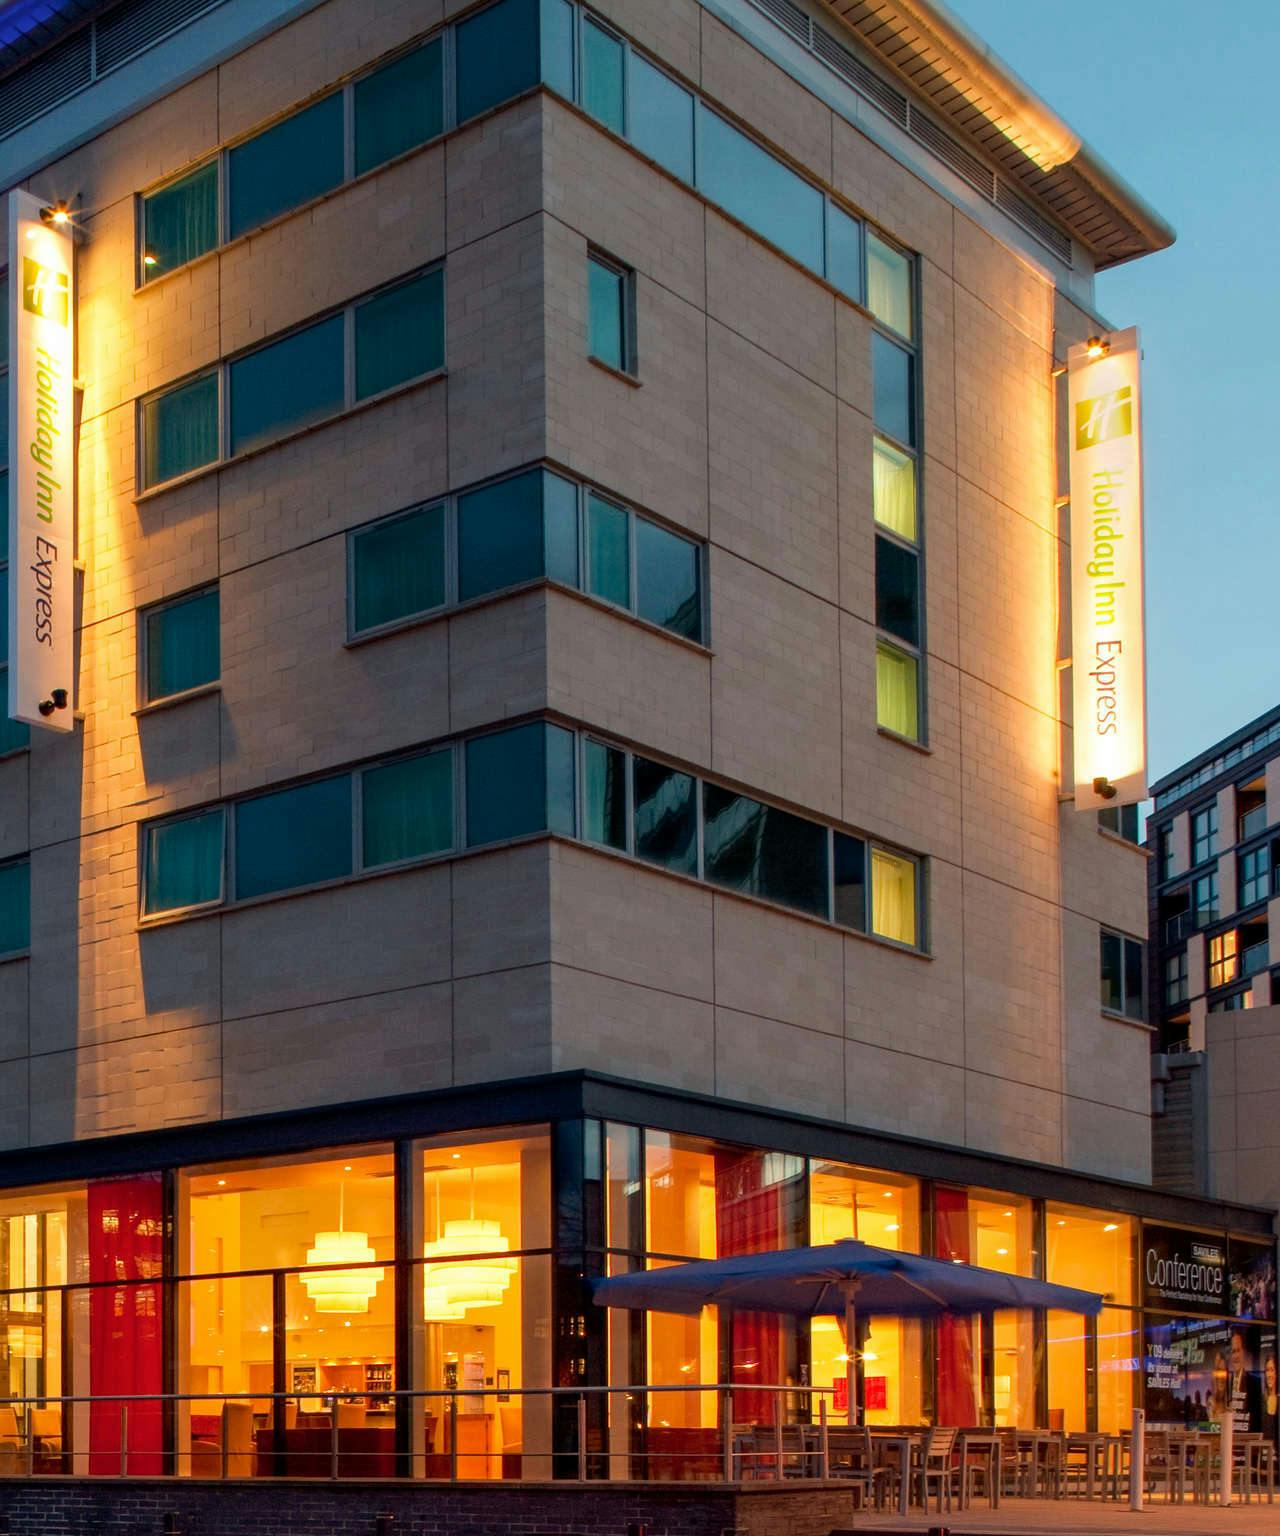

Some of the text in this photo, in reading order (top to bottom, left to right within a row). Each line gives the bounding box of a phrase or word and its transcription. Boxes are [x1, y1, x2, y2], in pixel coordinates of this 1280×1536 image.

[30, 346, 62, 647] Holiday Inn Express
[1086, 469, 1126, 735] Holiday Inn Express
[1146, 1248, 1223, 1294] Conference
